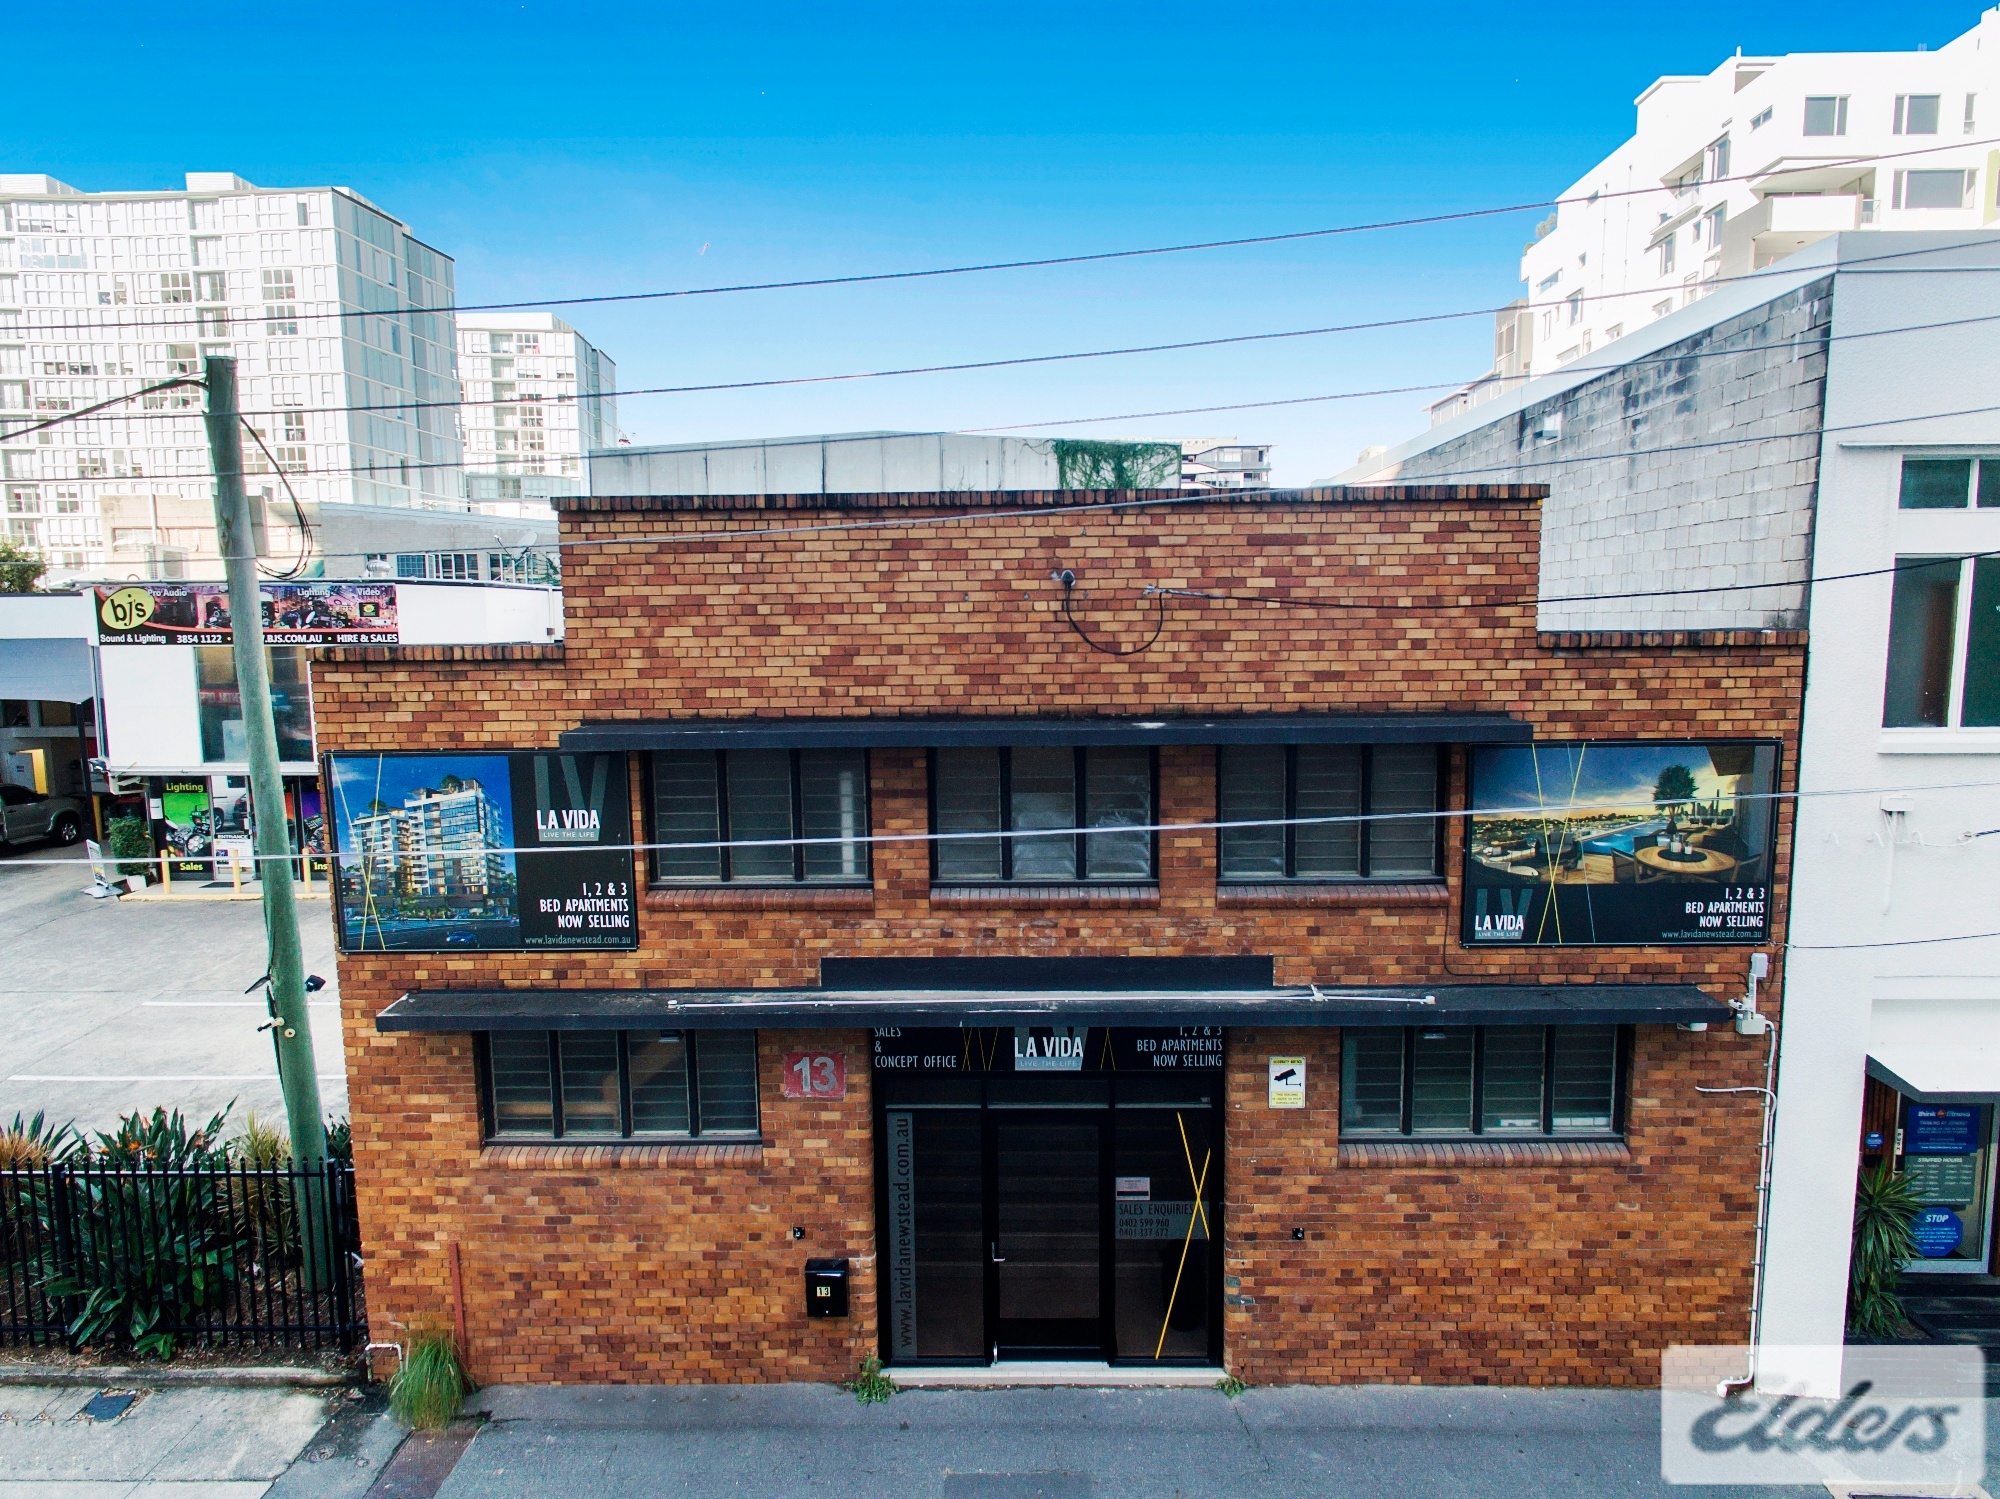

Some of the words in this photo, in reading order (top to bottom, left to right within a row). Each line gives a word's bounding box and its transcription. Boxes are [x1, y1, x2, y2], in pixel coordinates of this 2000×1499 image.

[147, 589, 161, 597] Pro
[162, 588, 188, 597] Audio
[297, 587, 331, 598] Lighting
[357, 587, 381, 596] Video
[109, 593, 148, 627] bj's
[100, 634, 125, 644] Sound
[127, 634, 133, 643] &
[134, 633, 167, 645] Lighting
[176, 634, 199, 644] 3854
[200, 634, 223, 644] 1122
[263, 633, 323, 643] .BJS.COM.AU
[336, 633, 359, 643] HIRE
[360, 633, 369, 643] &
[370, 633, 398, 643] SALES
[166, 782, 204, 793] Lighting
[536, 809, 559, 830] LA
[561, 809, 601, 830] VIDA
[180, 862, 204, 871] Sales
[595, 882, 602, 896] 2
[607, 882, 616, 896] &
[620, 882, 628, 896] 3
[1735, 887, 1743, 899] 2
[1746, 887, 1755, 899] &
[1758, 887, 1766, 899] 3
[539, 898, 561, 913] BED
[565, 898, 629, 912] APARTMENTS
[1685, 901, 1704, 914] BED
[1707, 901, 1765, 914] APARTMENTS
[557, 914, 583, 928] NOW
[588, 914, 630, 928] SELLING
[1475, 914, 1492, 931] LA
[1494, 914, 1525, 931] VIDA
[1699, 915, 1723, 928] NOW
[1726, 915, 1764, 927] SELLING
[1661, 928, 1763, 938] www.lavidanewstead.com.au
[524, 934, 631, 945] www.lavidanewstead.com.au
[874, 1027, 902, 1038] SALES
[1191, 1026, 1198, 1036] 2
[1203, 1026, 1211, 1036] &
[1216, 1026, 1222, 1036] 3
[874, 1040, 882, 1053] &
[1014, 1036, 1038, 1058] LA
[1042, 1036, 1084, 1058] VIDA
[1136, 1039, 1157, 1052] BED
[1161, 1038, 1223, 1052] APARTMENTS
[874, 1055, 919, 1068] CONCEPT
[923, 1055, 957, 1068] OFFICE
[1153, 1054, 1178, 1067] NOW
[1183, 1054, 1222, 1067] SELLING
[793, 1056, 838, 1092] 13
[1119, 1203, 1144, 1215] SALES
[1148, 1203, 1194, 1216] ENQUIRIES
[1119, 1218, 1138, 1228] 0402
[1139, 1218, 1154, 1228] 599
[1155, 1218, 1170, 1228] 960
[1925, 1214, 1950, 1223] STOP
[893, 1117, 913, 1349] www.lavidanewstead.com.au
[1119, 1228, 1137, 1237] 0401
[818, 1287, 830, 1296] 13
